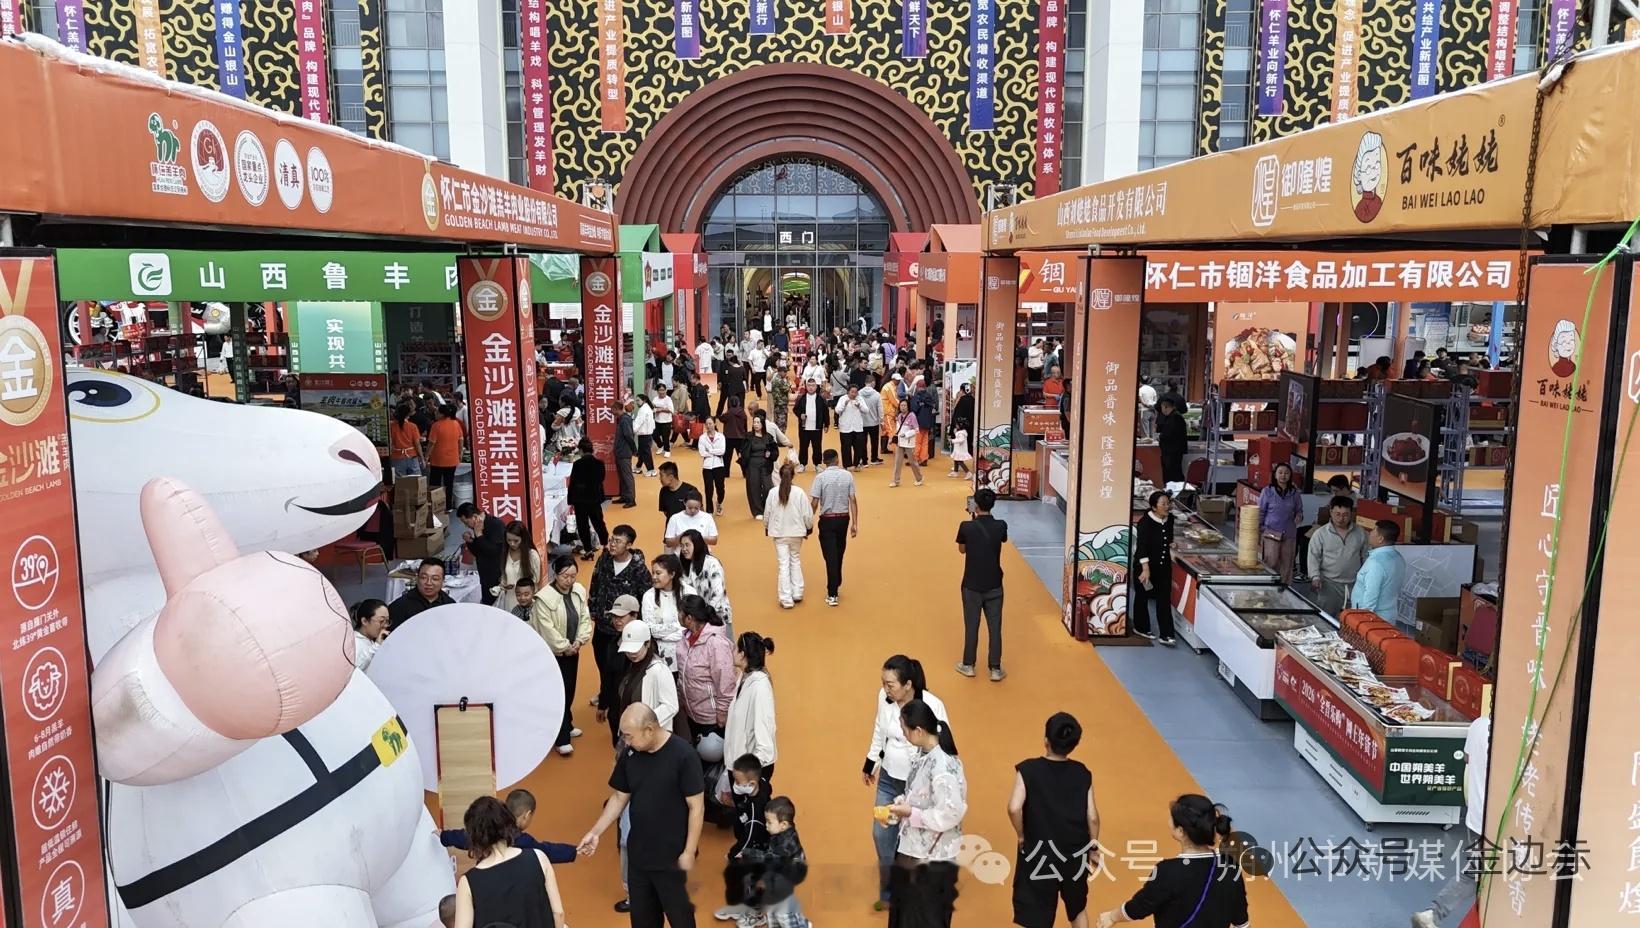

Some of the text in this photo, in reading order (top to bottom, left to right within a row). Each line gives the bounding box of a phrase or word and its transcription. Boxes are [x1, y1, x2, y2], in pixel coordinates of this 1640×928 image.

[1, 0, 15, 35] 调整结
[681, 1, 693, 38] 新蓝图
[756, 0, 768, 25] 新行
[832, 0, 844, 26] 银山
[909, 1, 921, 38] 鲜天下
[144, 29, 158, 74] 拓宽农
[221, 3, 238, 86] 赚得金山银山
[604, 0, 619, 100] 进产业提质转型
[976, 0, 988, 99] 宽农民增收渠道
[1265, 9, 1281, 97] 怀仁羊业向新行
[1418, 2, 1435, 86] 共绘产业新蓝图
[1042, 1, 1058, 174] 品牌 构建现代畜牧业体系
[531, 78, 547, 176] 科学管理发羊财
[280, 161, 299, 188] 清真
[311, 166, 329, 183] 100%
[1397, 129, 1499, 185] 百味姥姥
[1281, 157, 1333, 197] 御隆煌
[424, 182, 437, 217] 金
[1402, 189, 1485, 210] BAI WEI LAO LAO
[444, 214, 473, 228] GOLDEN
[474, 217, 493, 231] BEACH
[494, 219, 509, 233] LAMB
[510, 221, 522, 235] MEAT
[779, 230, 814, 244] 西门
[592, 277, 605, 291] 金
[1145, 260, 1512, 290] 怀仁市锢洋食品加工有限公司
[476, 288, 498, 311] 金
[326, 319, 345, 373] 实现共
[594, 304, 615, 424] 金沙滩羔羊肉
[0, 335, 38, 400] 金
[1102, 361, 1120, 426] 御品晋味
[1550, 401, 1559, 409] WEI
[482, 333, 522, 520] 金沙滩羔羊肉
[475, 398, 490, 514] GOLDEN BEACH LAM
[25, 484, 44, 495] BEACH
[46, 479, 61, 489] LAMB
[1390, 762, 1445, 773] 中国朔美羊
[1400, 774, 1456, 785] 世界朔美羊
[51, 876, 75, 925] 真
